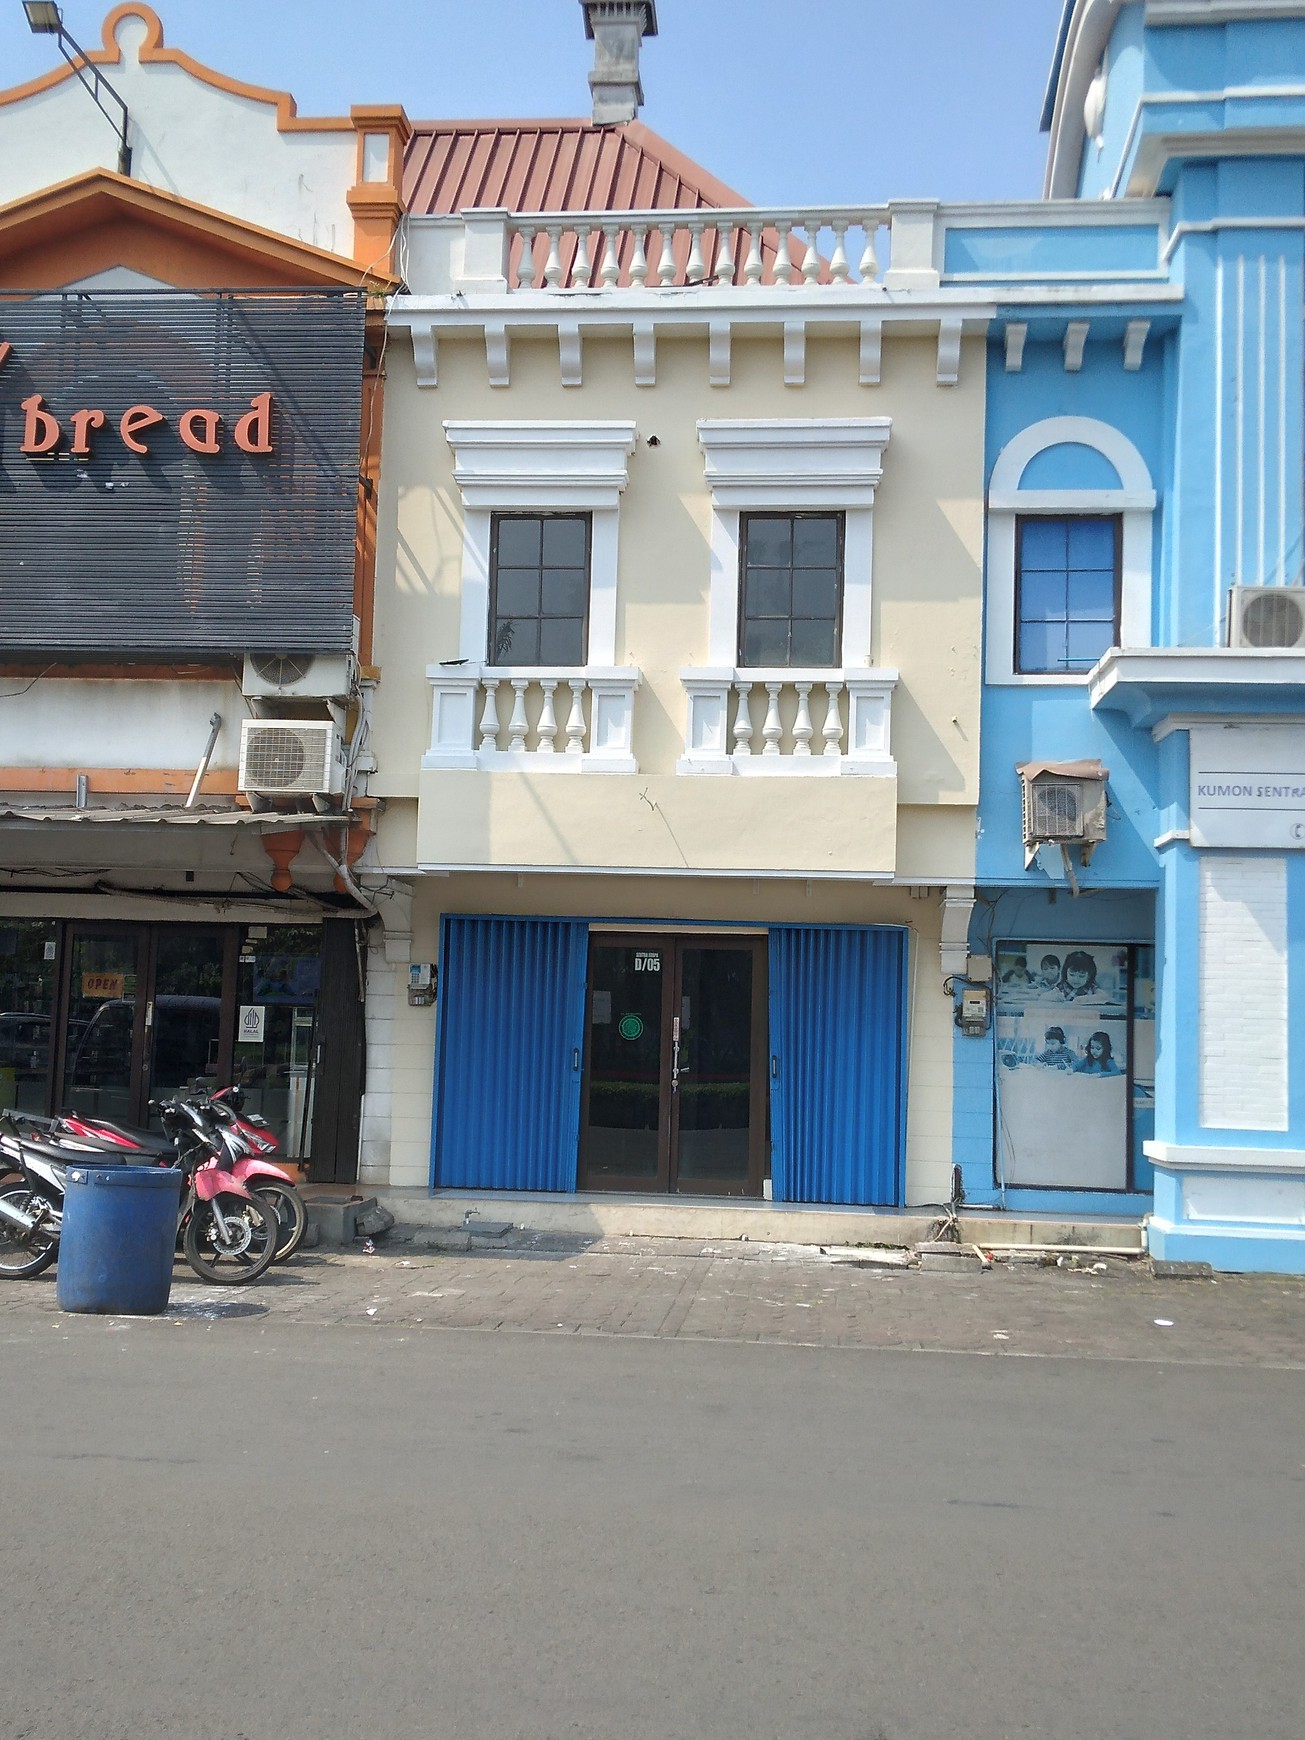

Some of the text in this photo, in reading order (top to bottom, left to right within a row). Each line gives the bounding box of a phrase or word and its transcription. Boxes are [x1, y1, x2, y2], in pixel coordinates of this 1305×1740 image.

[20, 392, 273, 454] bread
[1198, 785, 1252, 797] KUMON
[634, 957, 660, 971] D/05
[87, 978, 118, 990] OPEN
